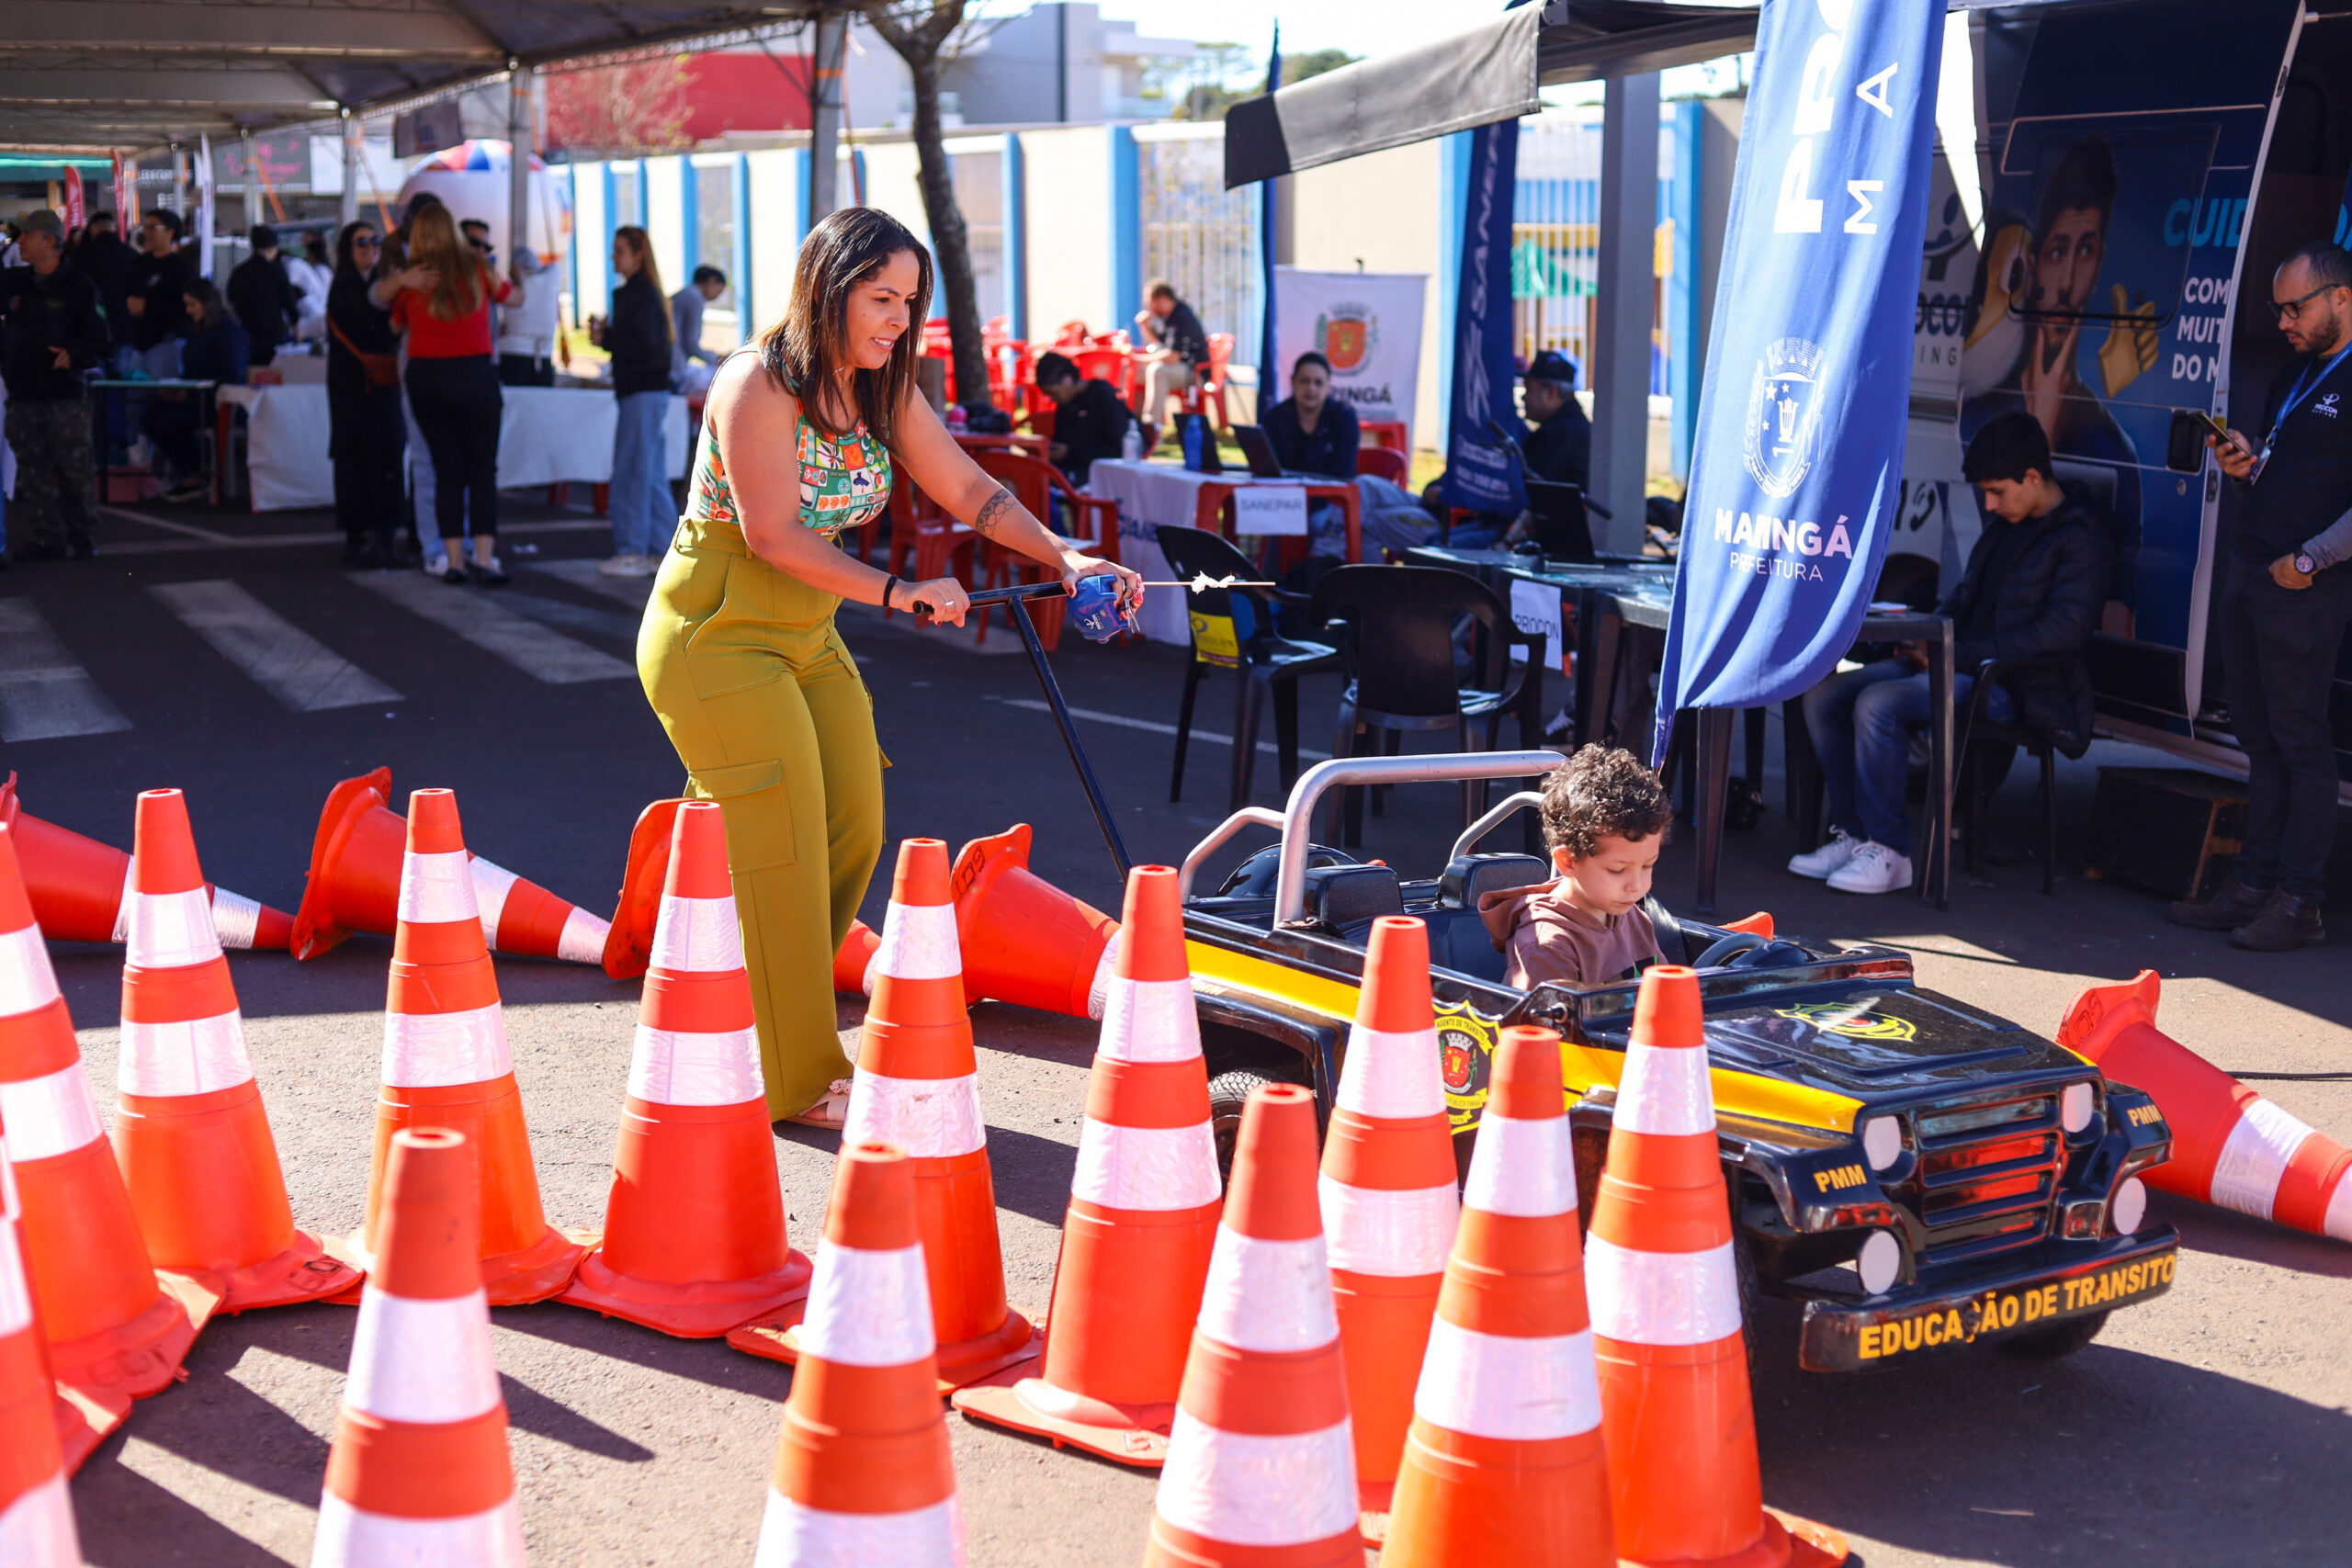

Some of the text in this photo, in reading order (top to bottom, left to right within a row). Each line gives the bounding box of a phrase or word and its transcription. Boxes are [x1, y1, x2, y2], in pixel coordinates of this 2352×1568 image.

[2171, 353, 2202, 382] DO
[1514, 614, 1560, 640] PROCON
[2126, 1104, 2164, 1128] PMM
[1813, 1163, 1868, 1193] PMM
[2024, 1282, 2059, 1322] DE
[2064, 1253, 2177, 1311] TRANSITO
